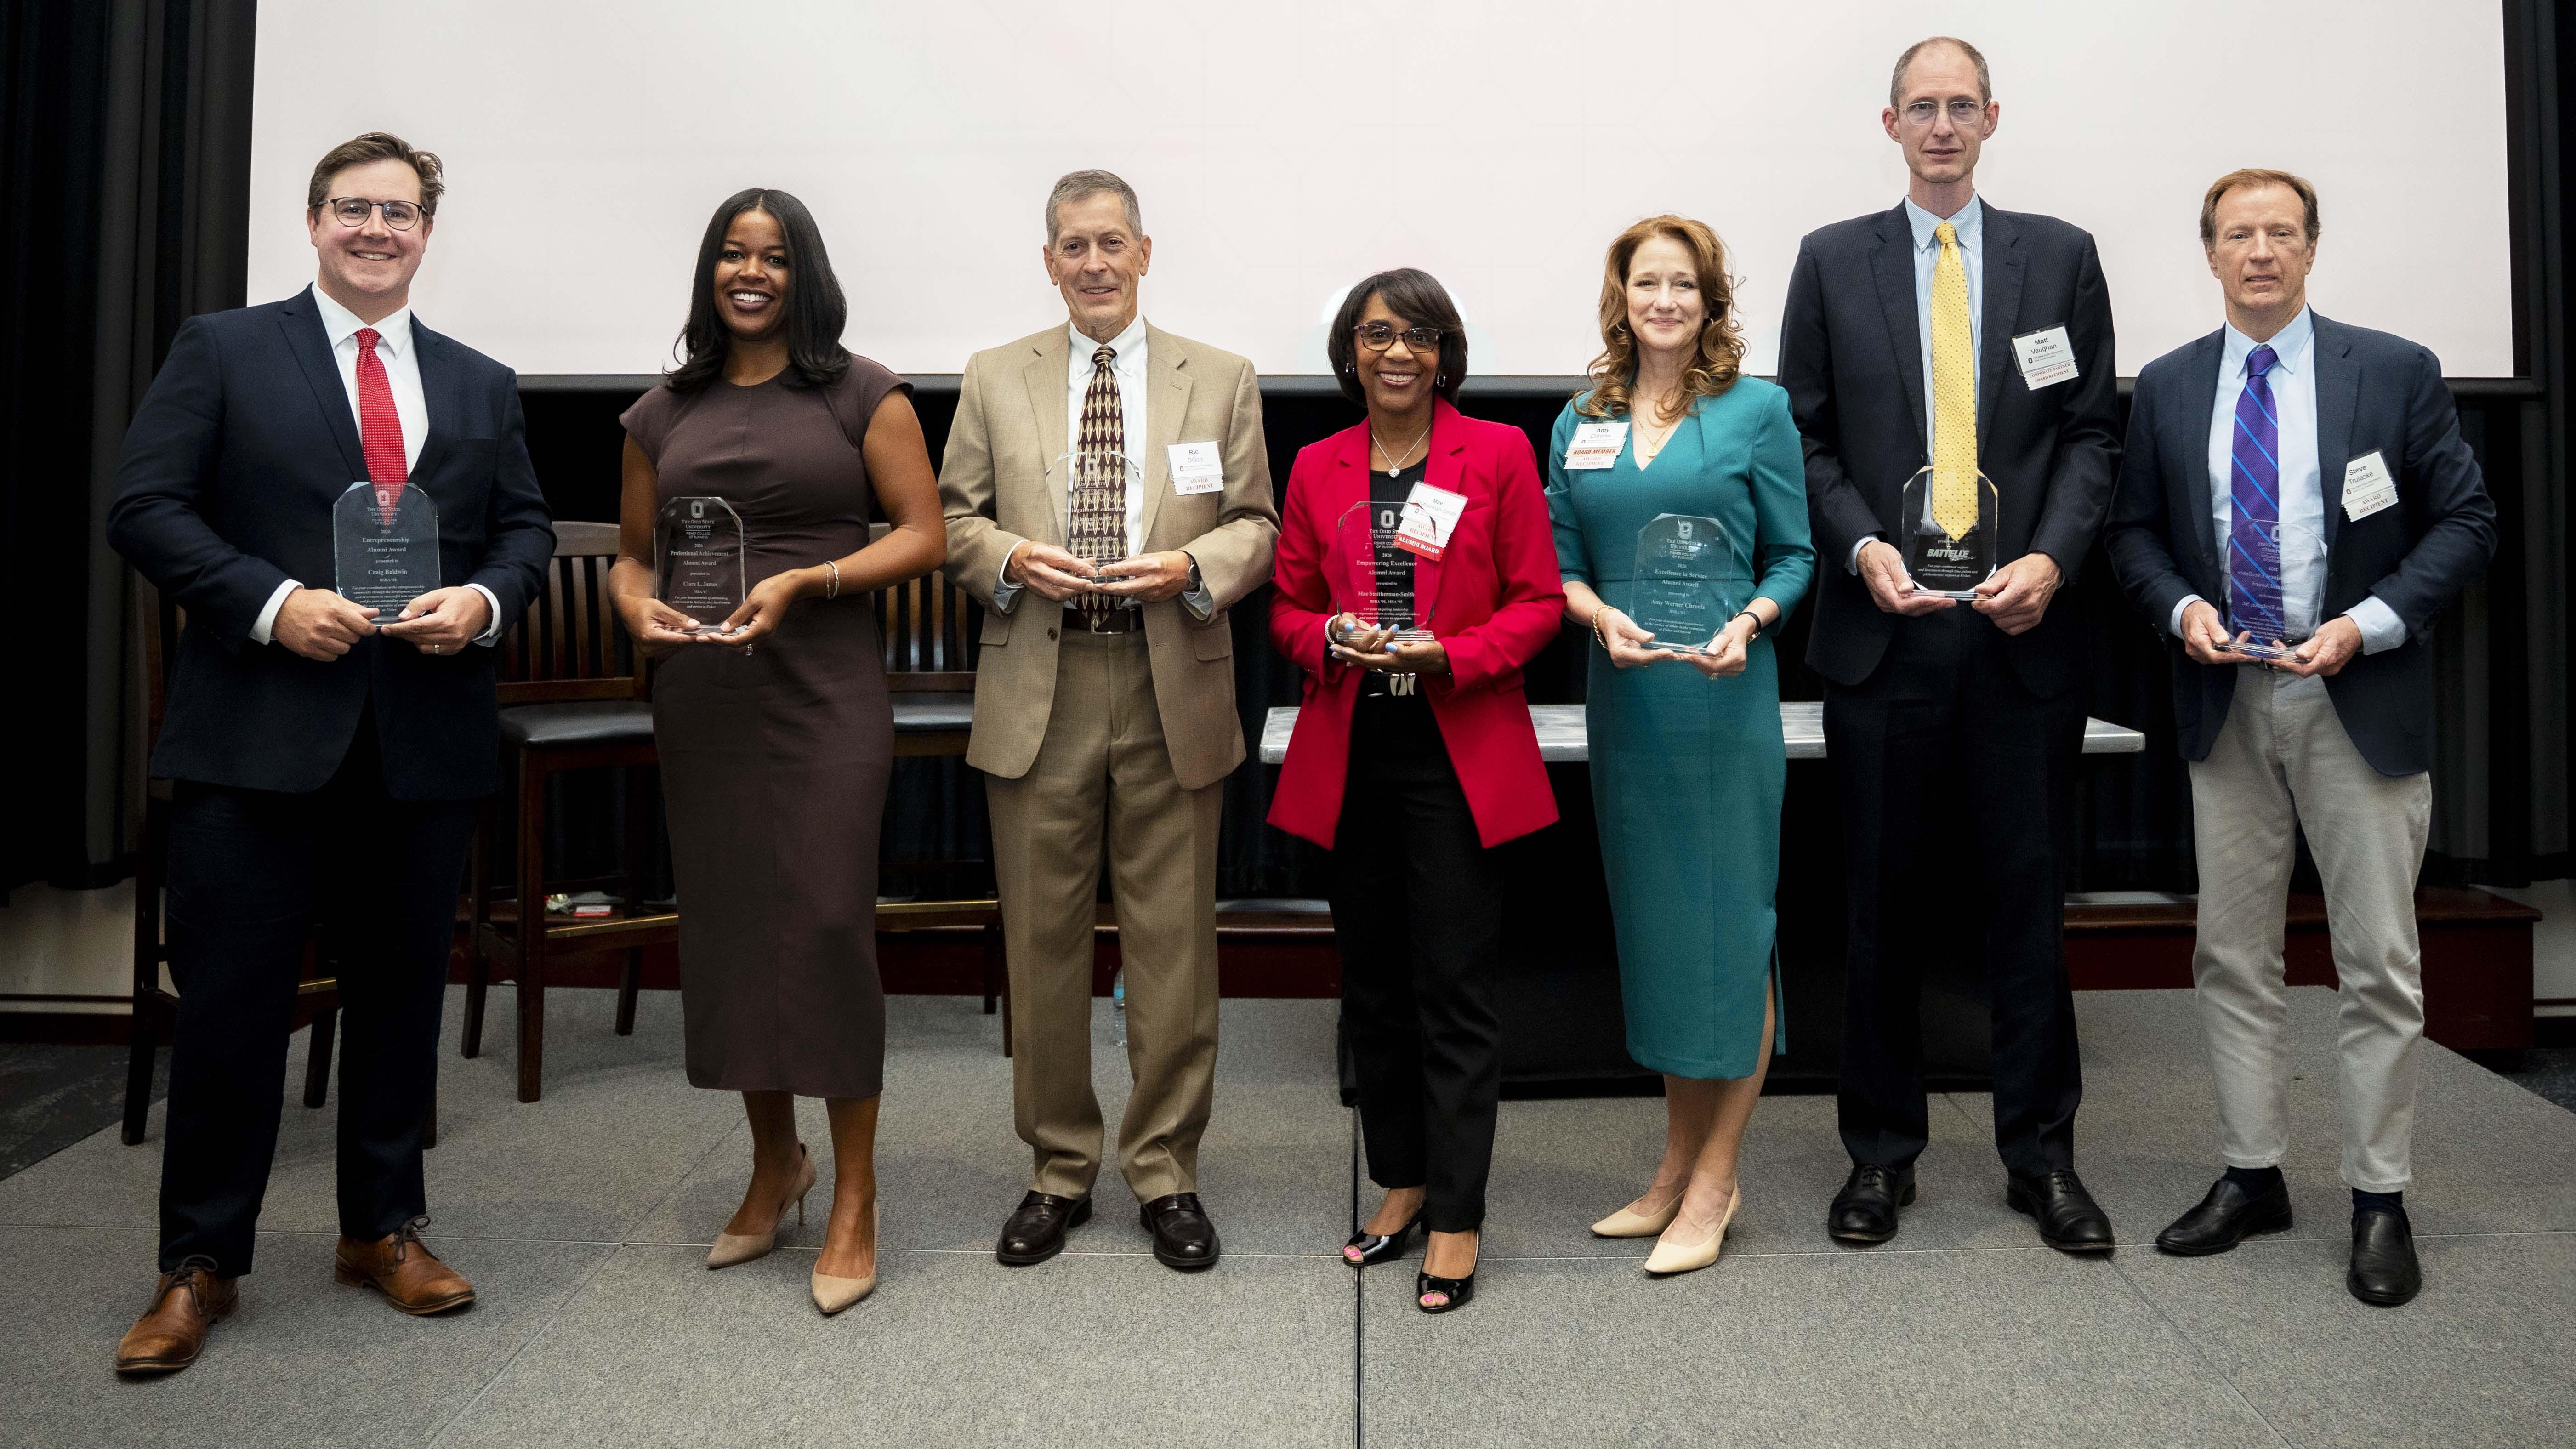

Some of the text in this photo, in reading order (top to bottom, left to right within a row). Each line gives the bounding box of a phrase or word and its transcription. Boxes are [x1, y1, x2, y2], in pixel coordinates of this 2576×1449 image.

[2030, 344, 2057, 354] Vaughan
[2029, 368, 2052, 378] CORPORATE
[2049, 369, 2069, 378] RECIPIENT
[2349, 465, 2366, 475] Steve
[2349, 472, 2373, 485] Trulaske
[2362, 494, 2381, 505] AWARD
[2359, 498, 2388, 513] RECIPIENT
[1399, 537, 1439, 554] ALUMNI BOARD
[1927, 549, 1970, 558] BATTELLE
[1655, 568, 1682, 577] Excellence
